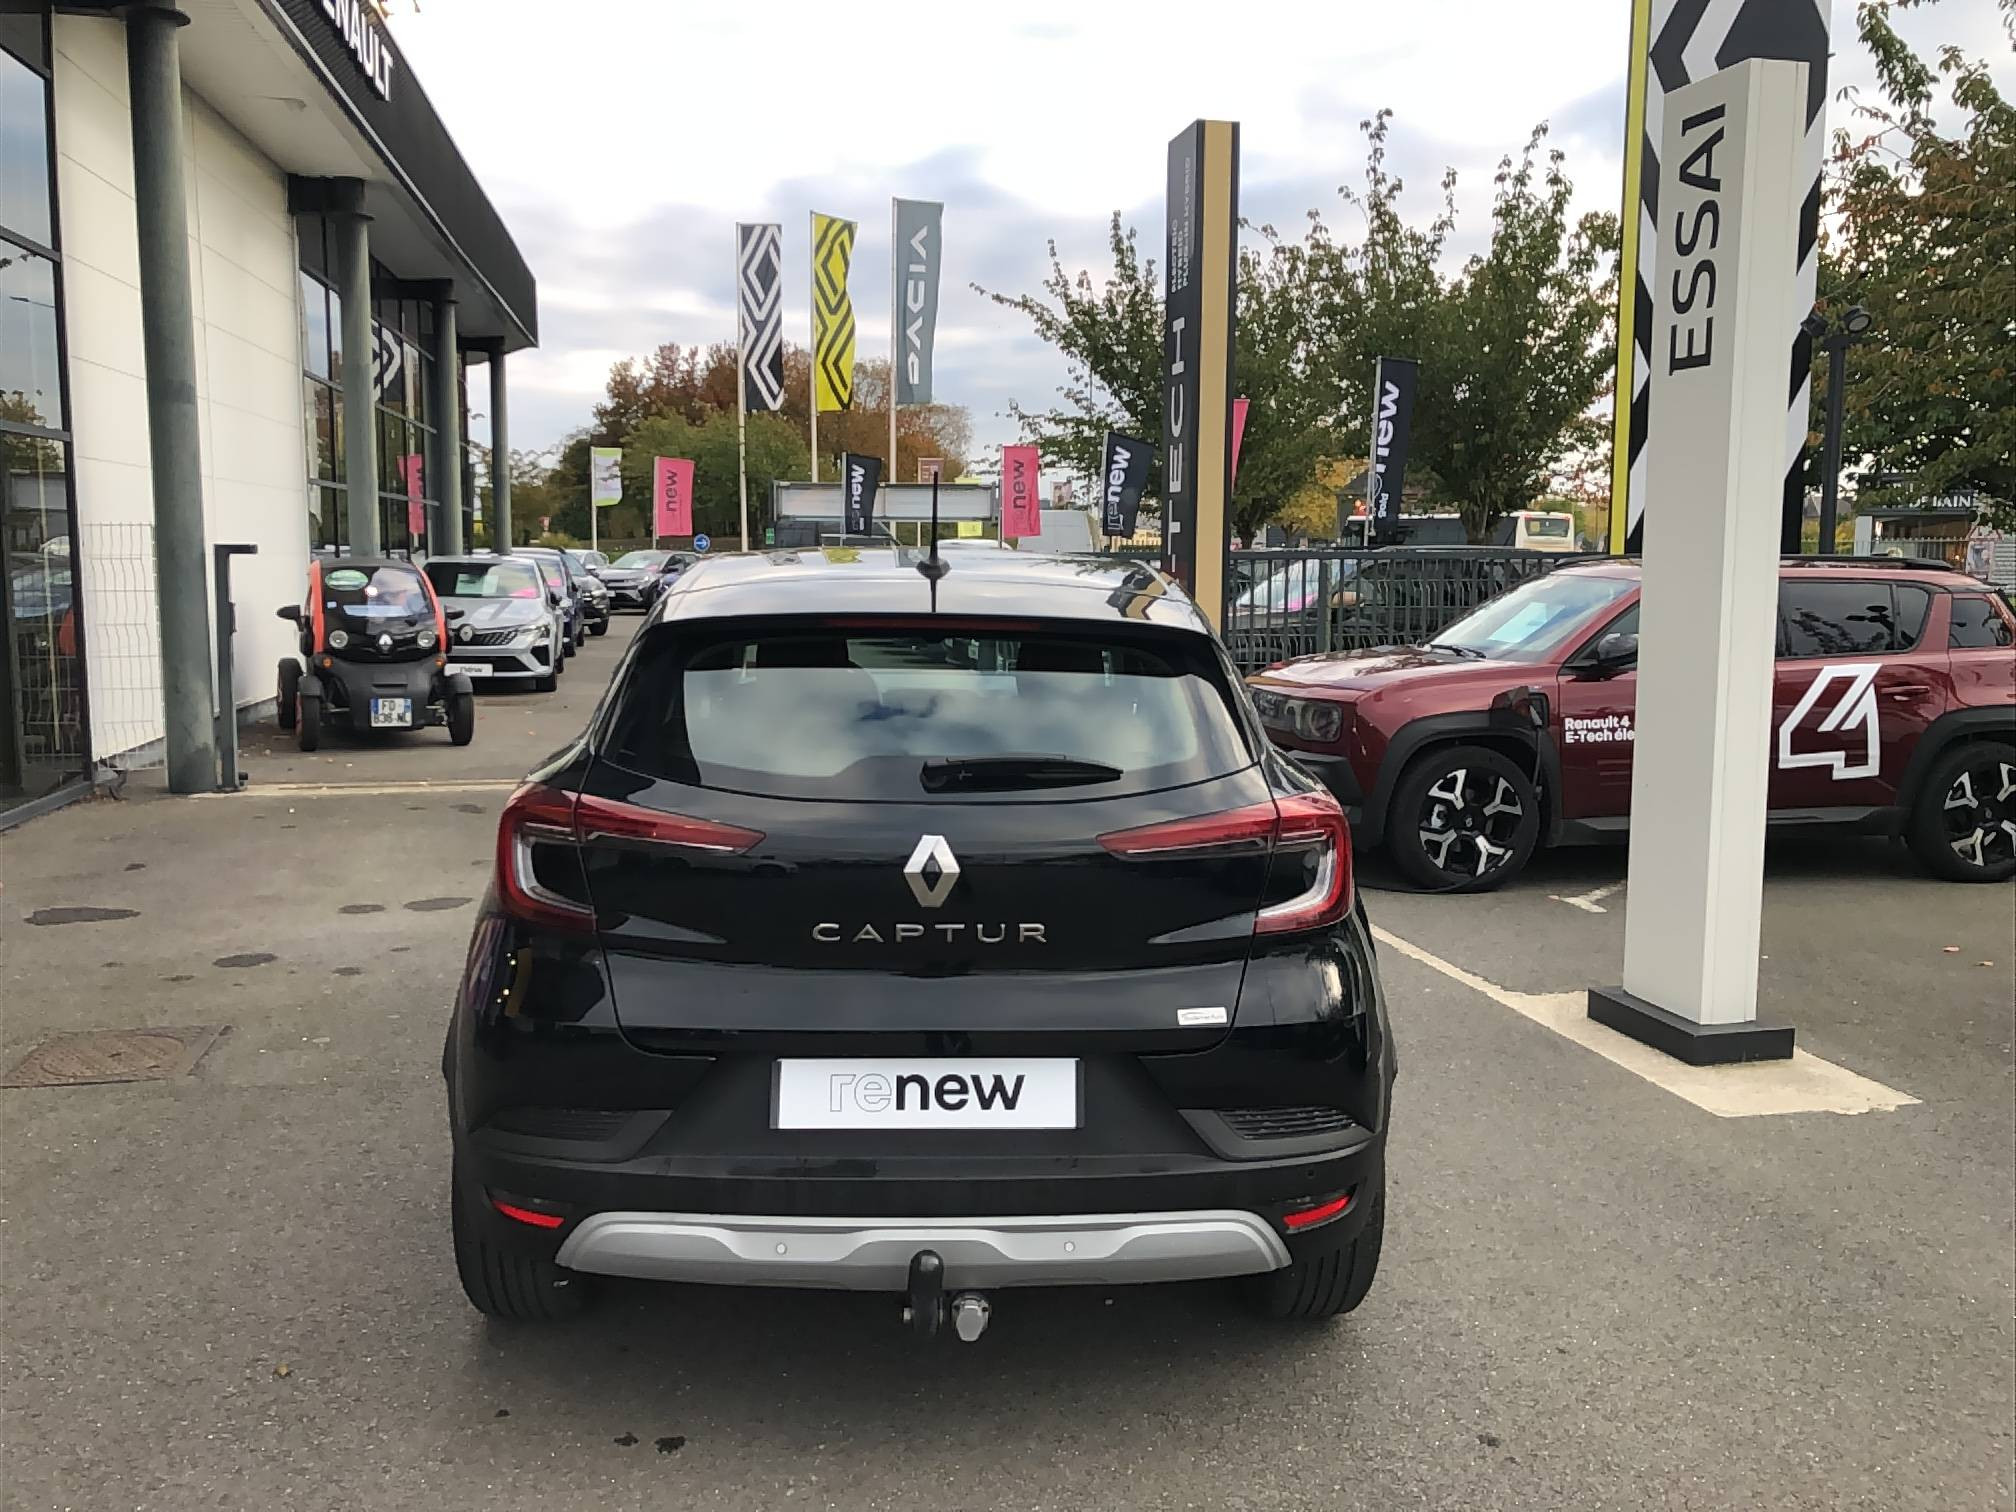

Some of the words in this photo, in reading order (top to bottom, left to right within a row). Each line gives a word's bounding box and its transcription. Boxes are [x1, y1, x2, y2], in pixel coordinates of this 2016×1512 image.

[1668, 103, 1727, 377] ESSAI
[906, 225, 928, 385] DACIA
[1107, 446, 1131, 531] renew
[1564, 715, 1619, 731] Renault
[1620, 715, 1631, 727] 4
[1565, 728, 1613, 743] E-Tech
[812, 923, 1047, 943] CAPTUR
[829, 1073, 1026, 1112] renew
